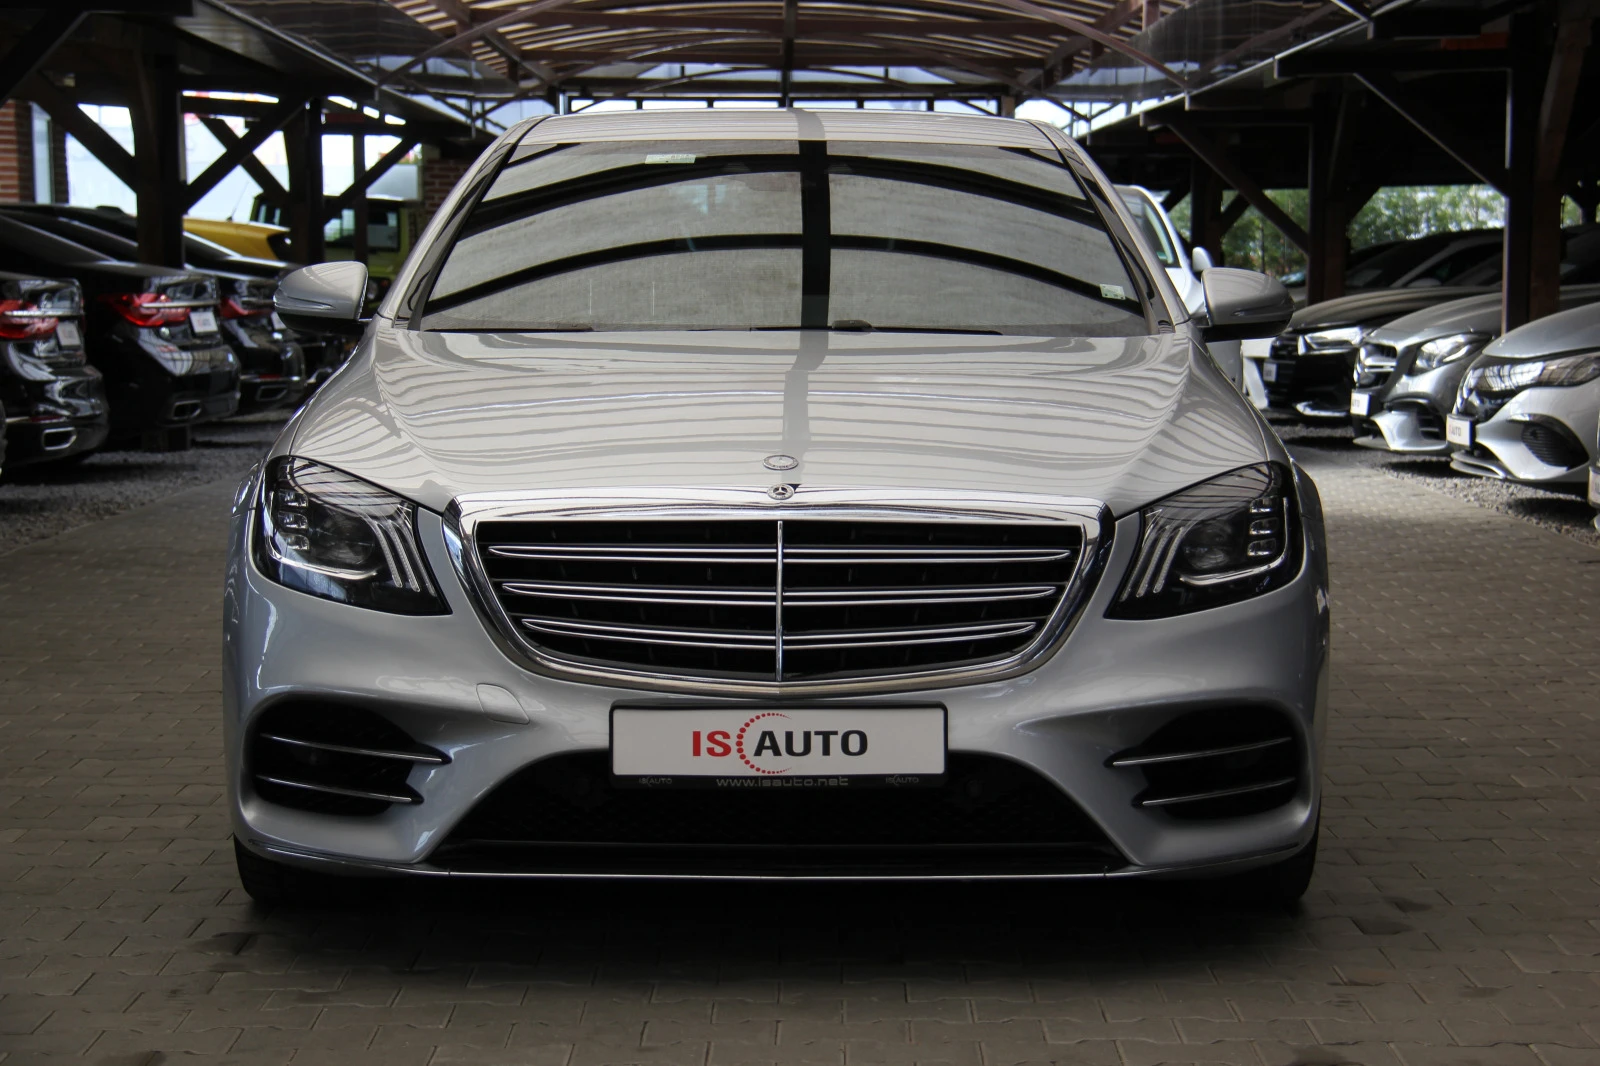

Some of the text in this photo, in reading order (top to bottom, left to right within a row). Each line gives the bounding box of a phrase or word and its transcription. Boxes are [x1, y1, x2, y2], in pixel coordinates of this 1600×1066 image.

[692, 730, 868, 757] IS AUTO
[716, 776, 849, 787] www.isauto.net
